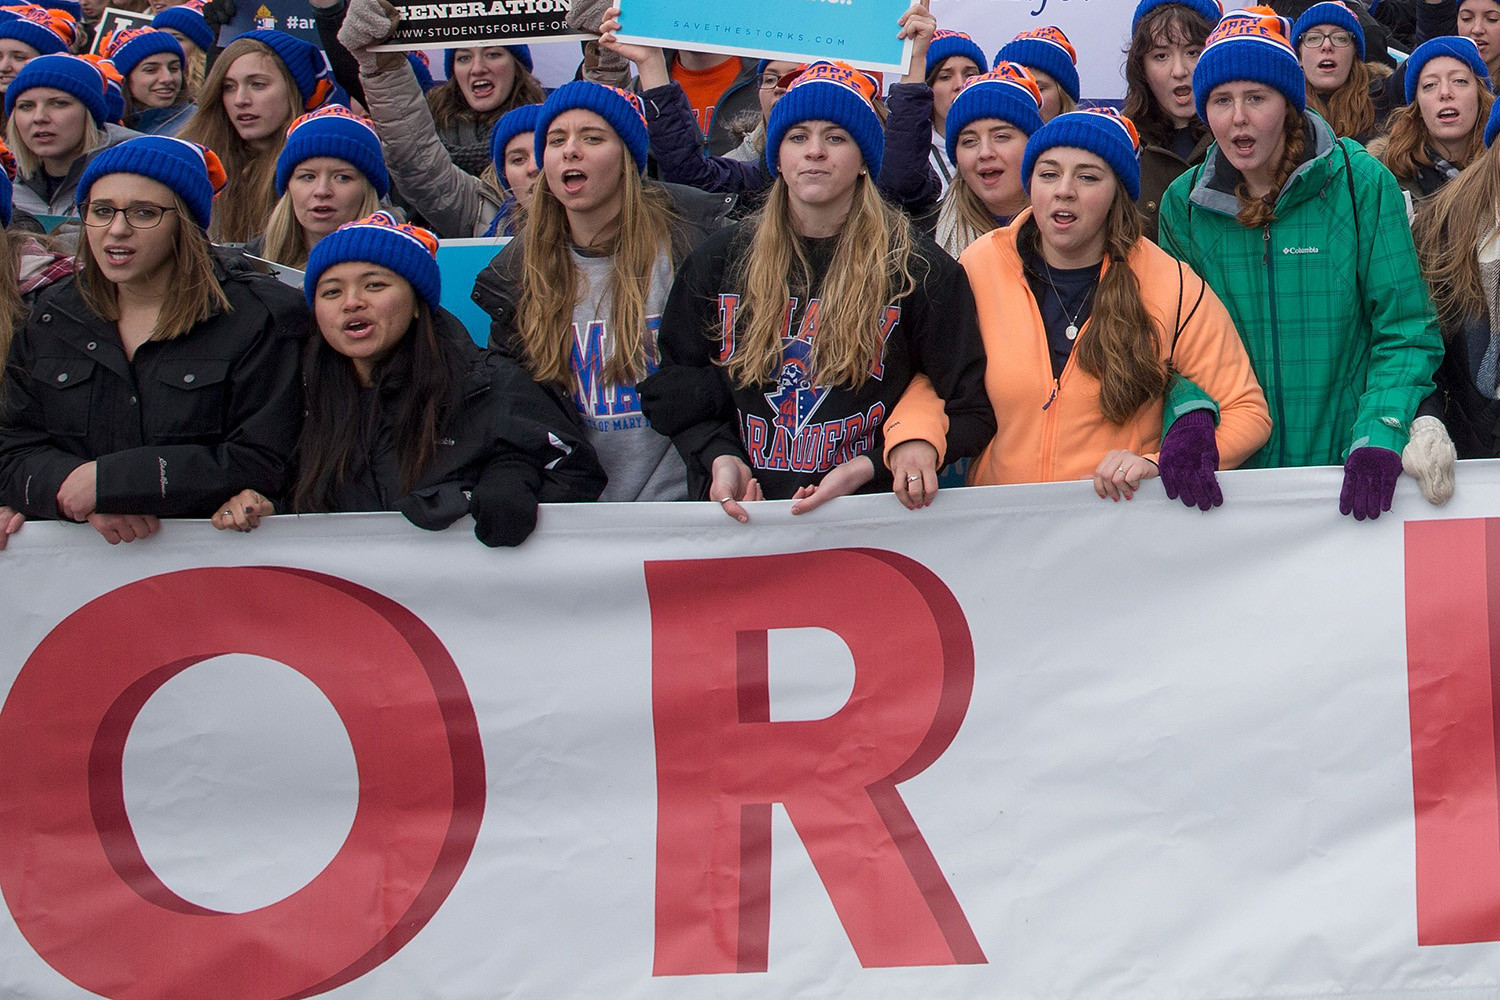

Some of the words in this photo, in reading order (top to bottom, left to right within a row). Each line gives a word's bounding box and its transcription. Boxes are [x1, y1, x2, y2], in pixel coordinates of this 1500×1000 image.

[673, 20, 846, 46] SAVETHESTORKS.COM
[1289, 246, 1319, 255] Columbia
[599, 420, 609, 432] OF
[613, 417, 641, 430] MARY
[0, 546, 988, 1000] OR
